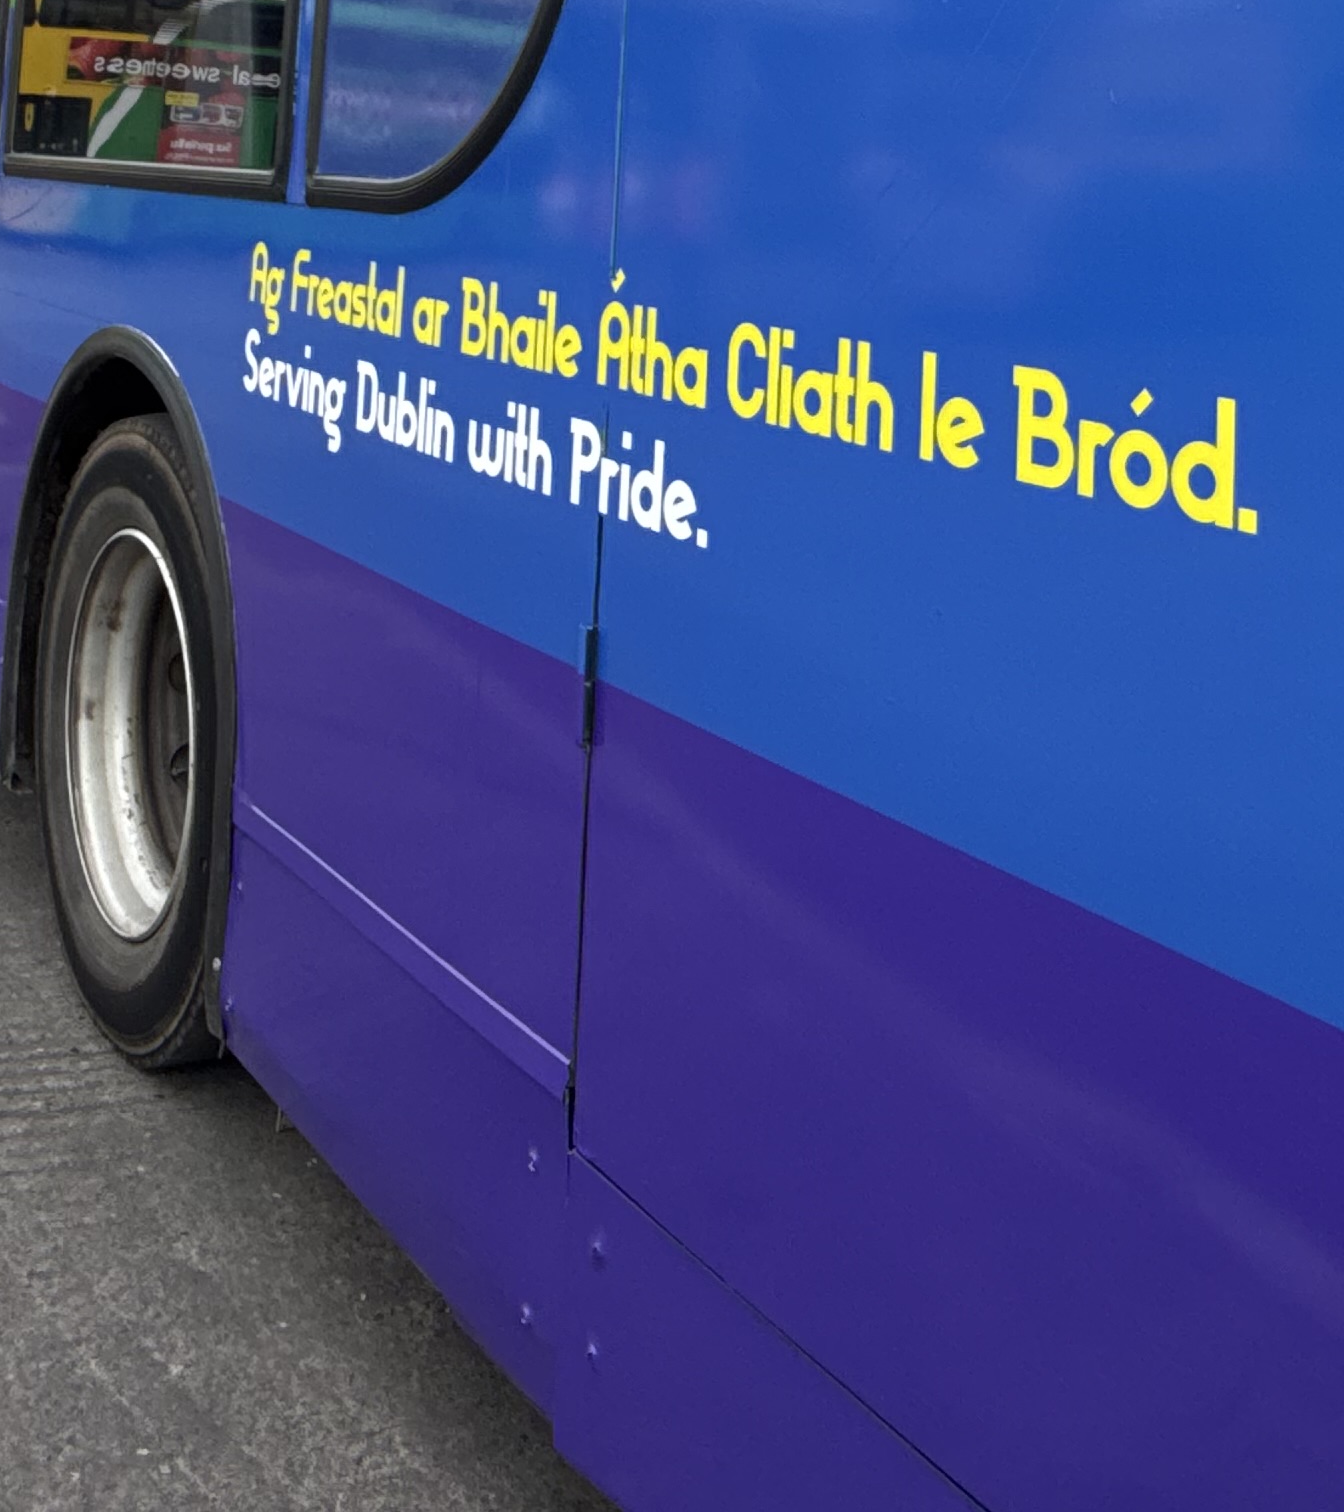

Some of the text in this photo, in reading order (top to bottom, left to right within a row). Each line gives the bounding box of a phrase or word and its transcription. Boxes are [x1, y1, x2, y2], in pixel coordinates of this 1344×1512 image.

[242, 328, 709, 550] Serving Dublin with Pride.
[250, 241, 1258, 534] Ag Freastal ar Bhaile Átha Cliath le Bród.
